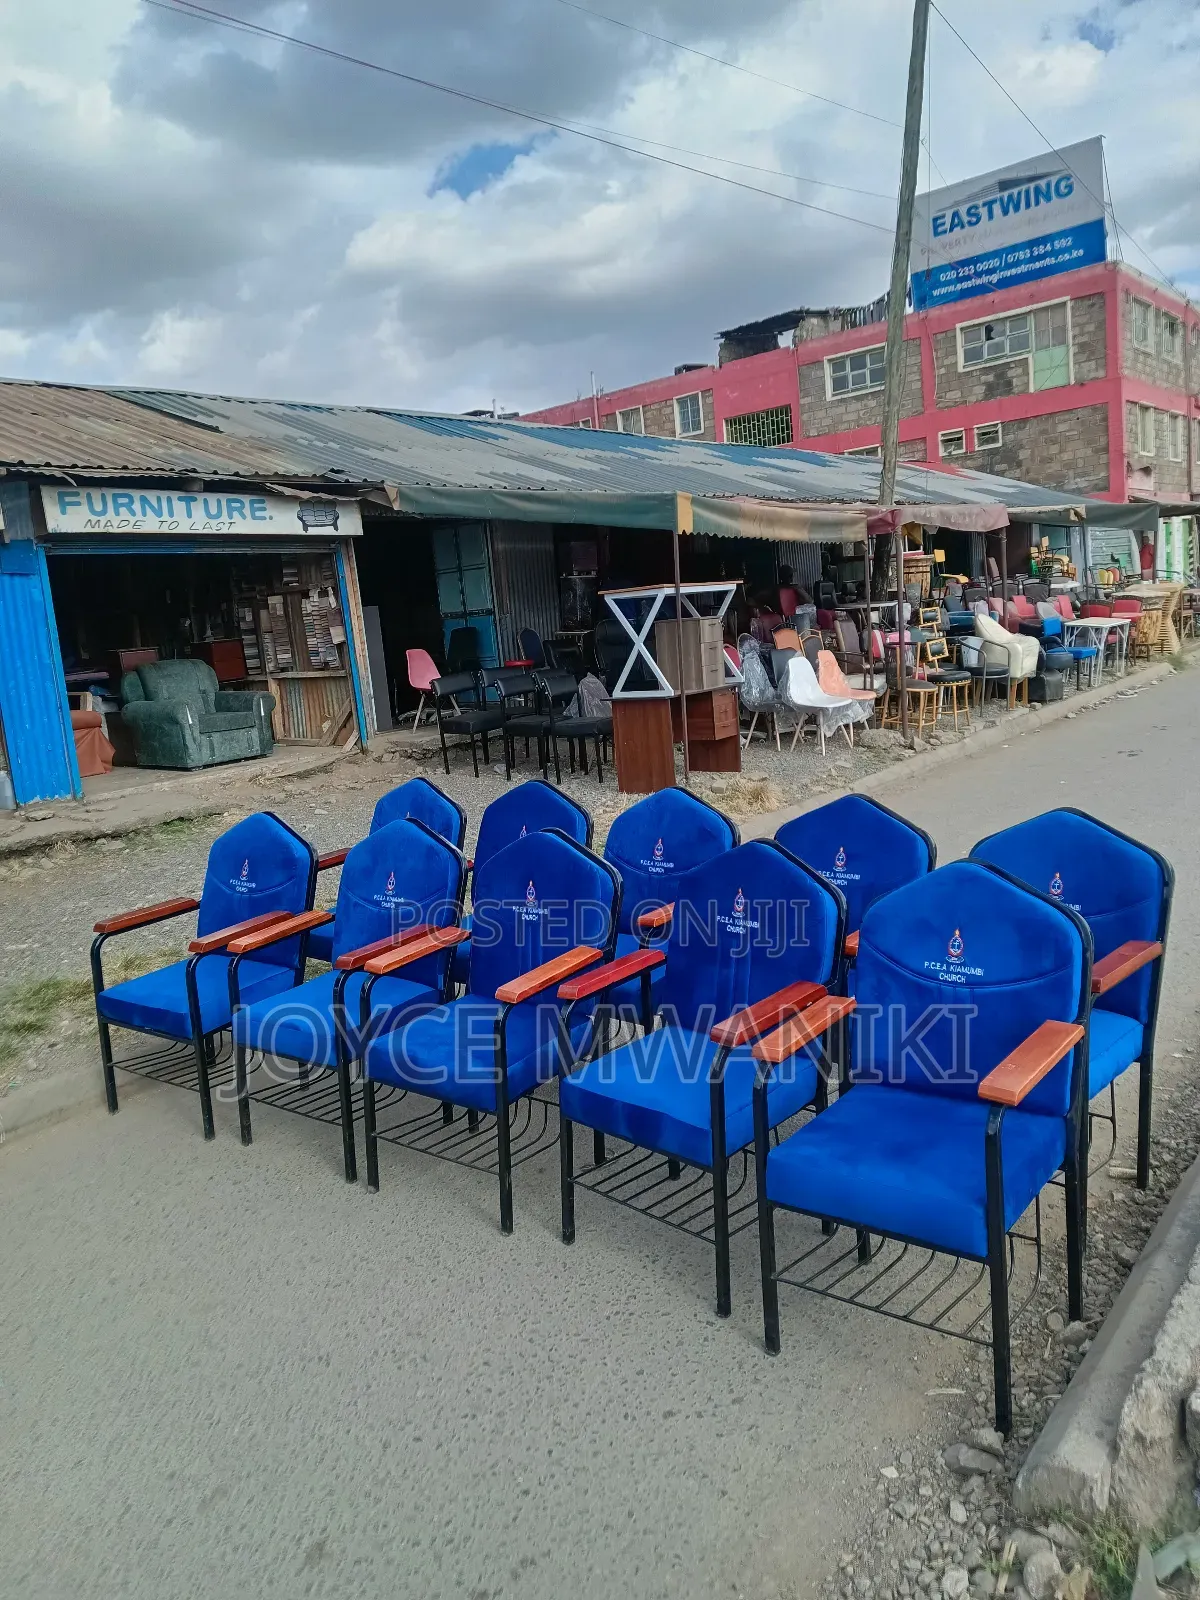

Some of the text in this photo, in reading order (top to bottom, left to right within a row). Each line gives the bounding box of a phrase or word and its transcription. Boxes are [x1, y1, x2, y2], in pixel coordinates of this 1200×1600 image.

[931, 174, 1075, 238] EASTWING
[932, 248, 1084, 297] www.eastwinginvestments.co.ke
[57, 491, 273, 521] FURNITURE.
[84, 518, 237, 532] MADE TO LAST
[939, 972, 967, 984] CHURCH
